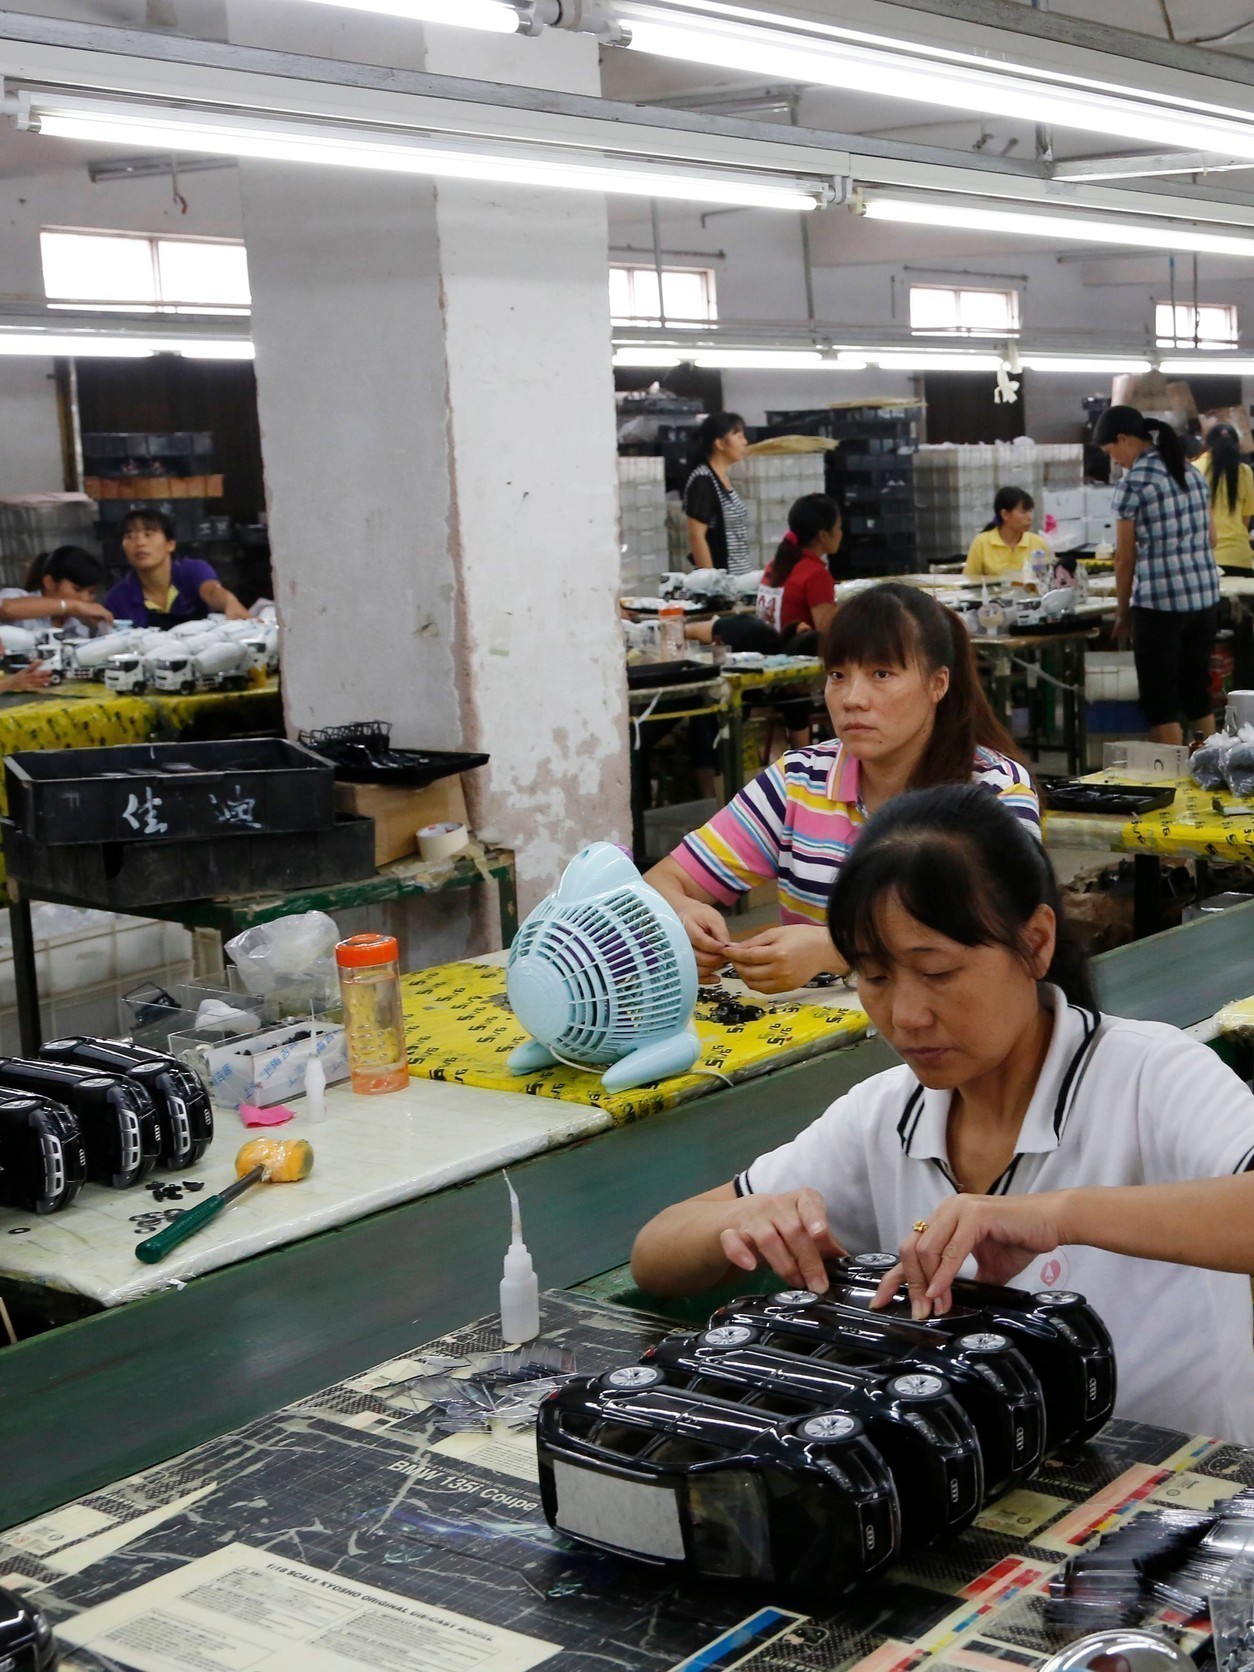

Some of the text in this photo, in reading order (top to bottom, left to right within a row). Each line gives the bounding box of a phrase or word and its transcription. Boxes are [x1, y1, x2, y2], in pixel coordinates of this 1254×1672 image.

[387, 1460, 539, 1511] BMW 135i Coupe
[286, 1569, 318, 1585] SCALE
[319, 1580, 361, 1598] KYOSHO
[361, 1595, 409, 1613] ORIGINAL
